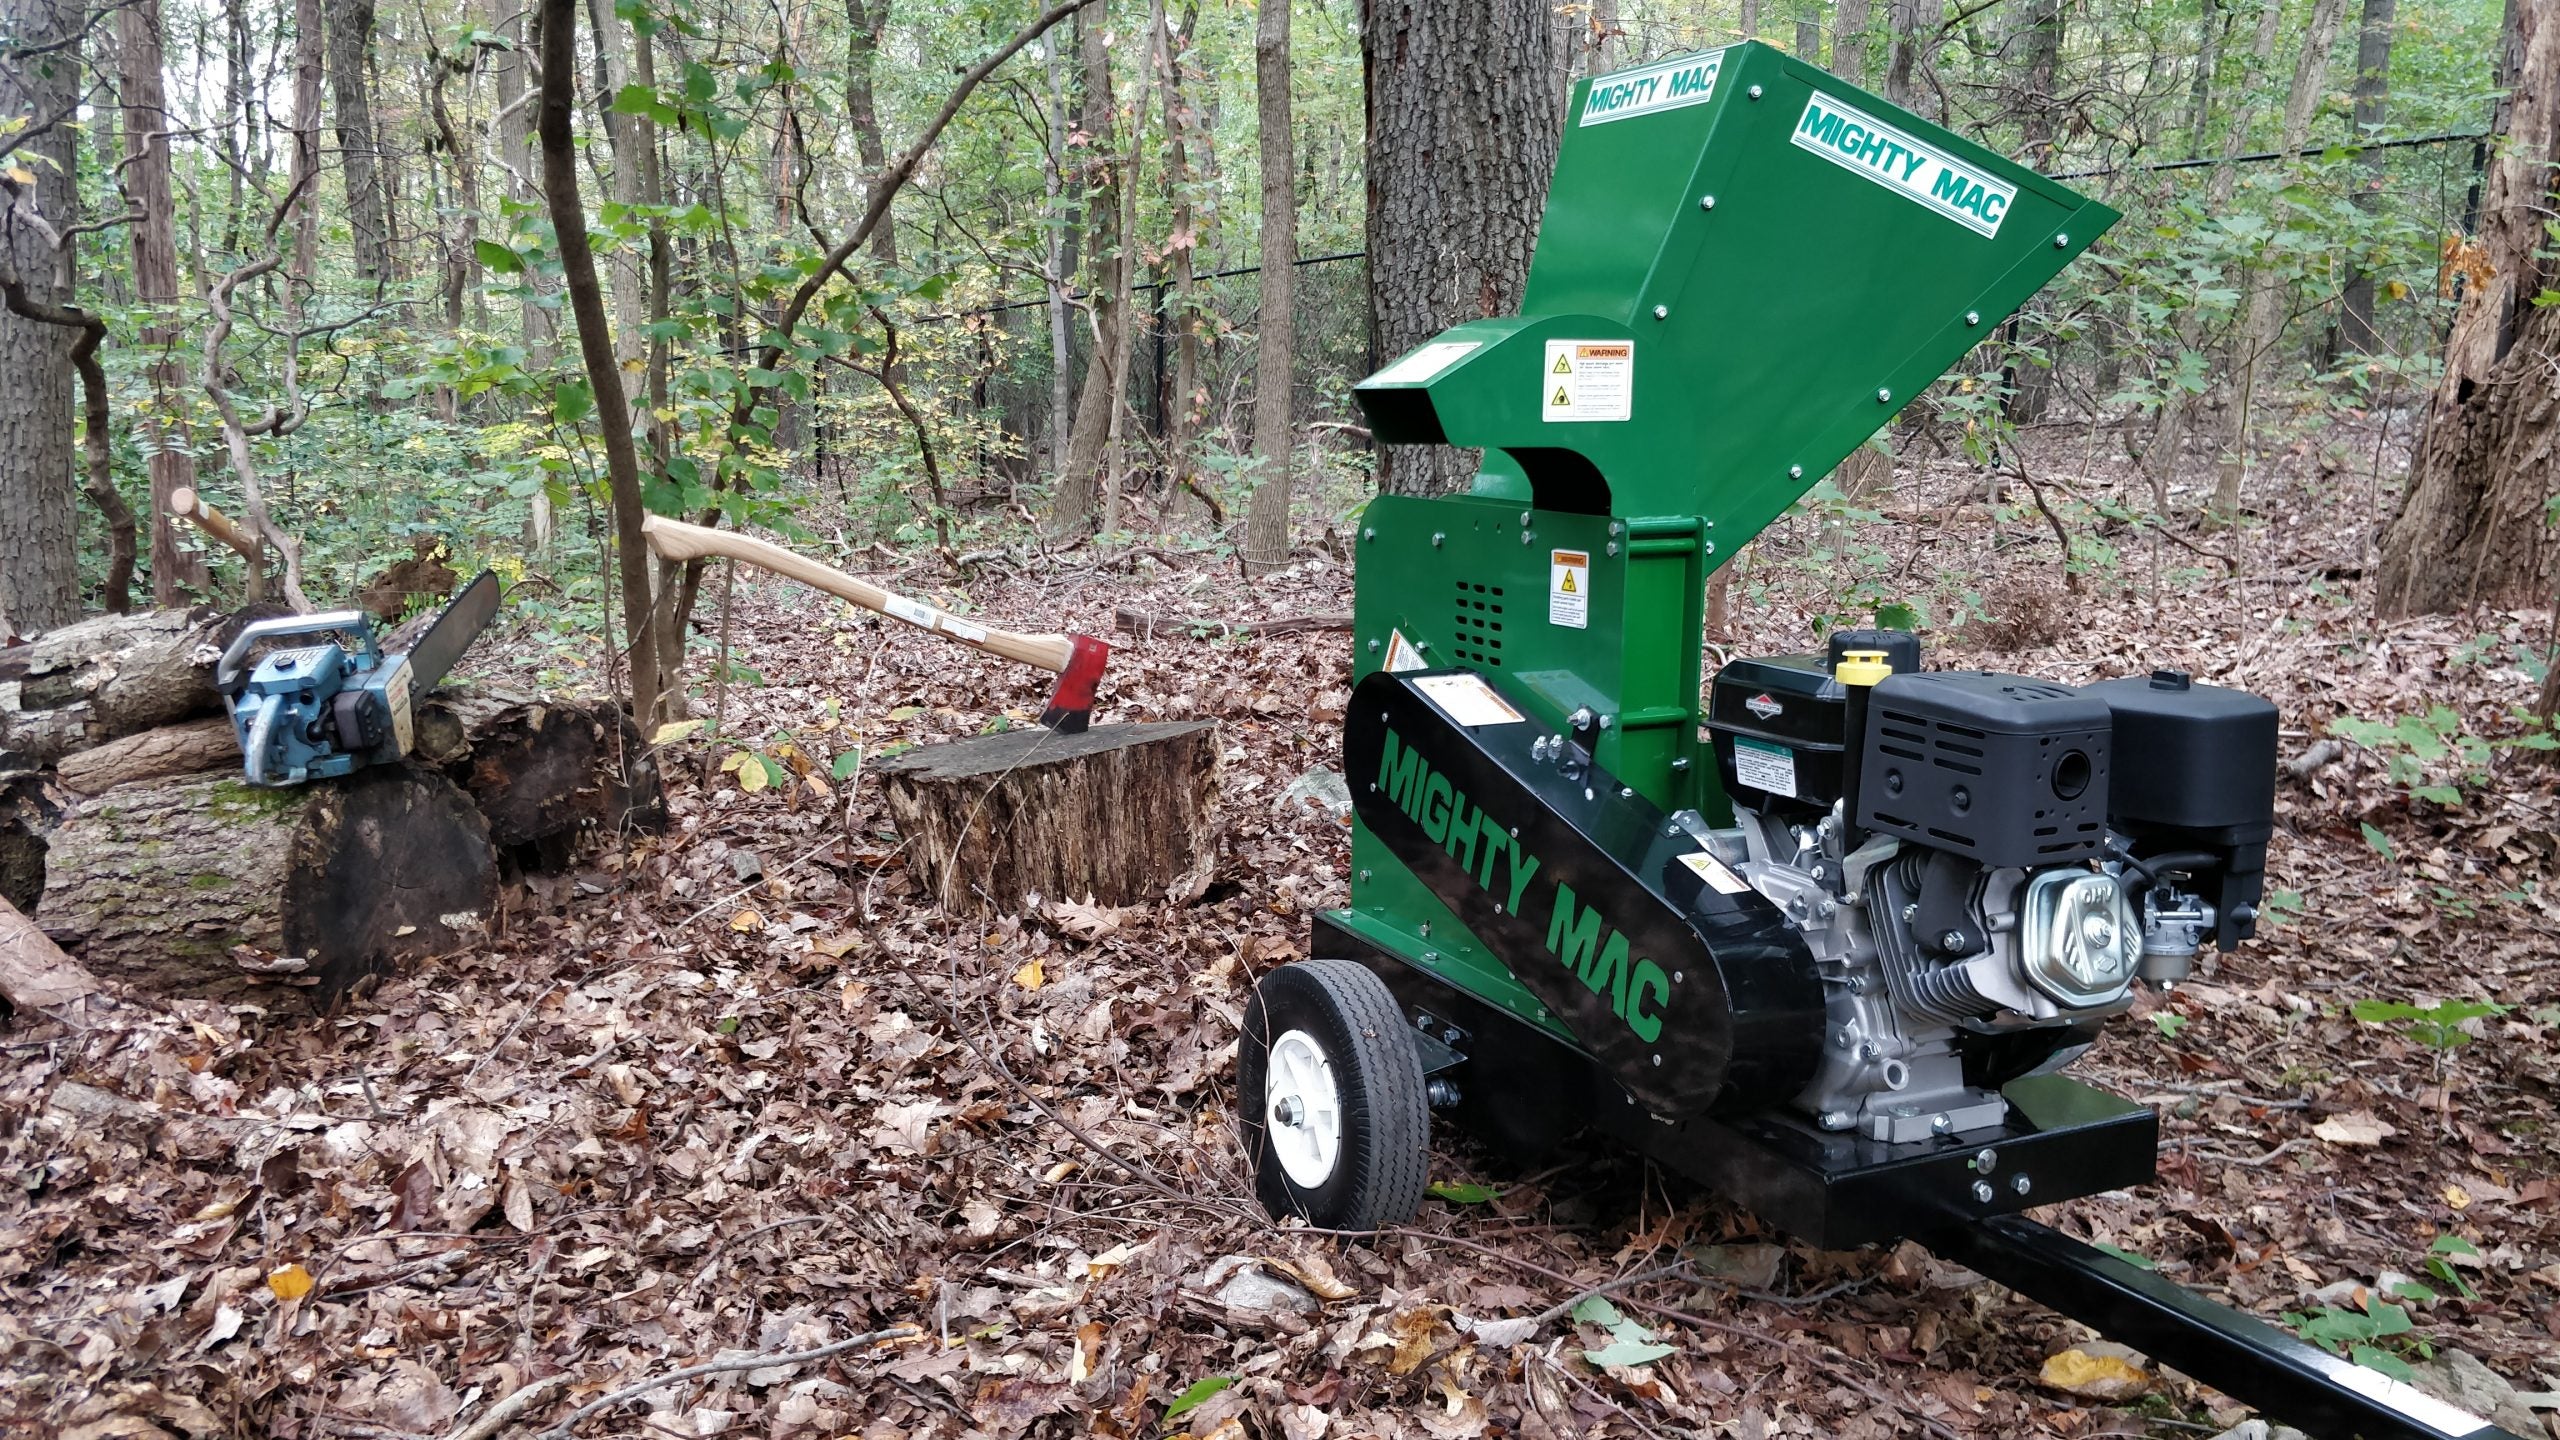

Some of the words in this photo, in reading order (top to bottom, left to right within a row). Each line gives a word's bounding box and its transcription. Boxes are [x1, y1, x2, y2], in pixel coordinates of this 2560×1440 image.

[1585, 74, 1663, 116] MIGHTY
[1665, 63, 1718, 99] MAC
[1798, 104, 1927, 182] MIGHTY
[1931, 167, 2006, 225] MAC
[1589, 349, 1627, 357] WARNING
[1377, 727, 1541, 918] MIGHTY
[1545, 879, 1670, 1044] MAC
[2080, 883, 2113, 905] OHV
